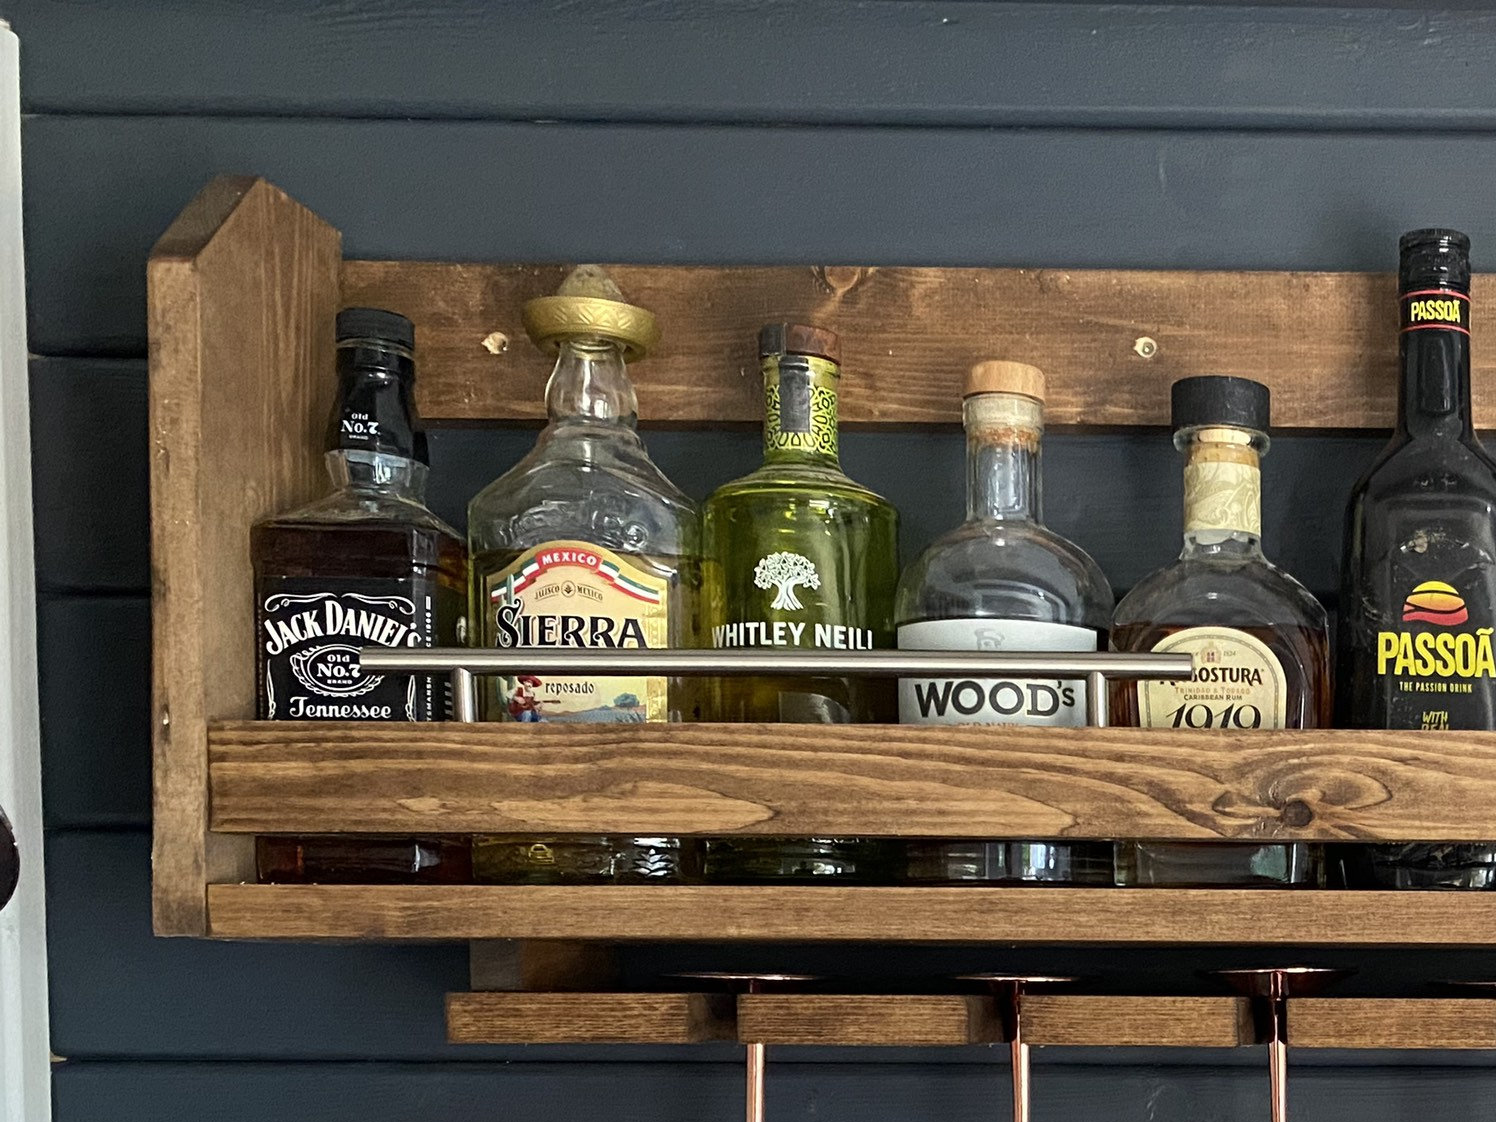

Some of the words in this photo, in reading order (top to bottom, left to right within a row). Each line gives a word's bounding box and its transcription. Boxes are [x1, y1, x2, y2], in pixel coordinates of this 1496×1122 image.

[351, 412, 369, 420] Old
[542, 551, 597, 566] MEXICO
[577, 585, 603, 600] MEXICO
[496, 598, 649, 648] SIERRA
[264, 610, 322, 655] JACK
[712, 622, 806, 648] WHITLEY
[327, 654, 350, 663] Old
[1377, 627, 1496, 678] PASSOÃ
[316, 663, 361, 678] No.7
[1160, 667, 1263, 686] OSTURA
[545, 682, 594, 695] reposado
[1400, 682, 1412, 691] THE
[1416, 682, 1447, 692] PASSION
[1450, 683, 1472, 693] DRINK
[290, 696, 391, 718] Tennessee
[1423, 711, 1448, 723] WITH
